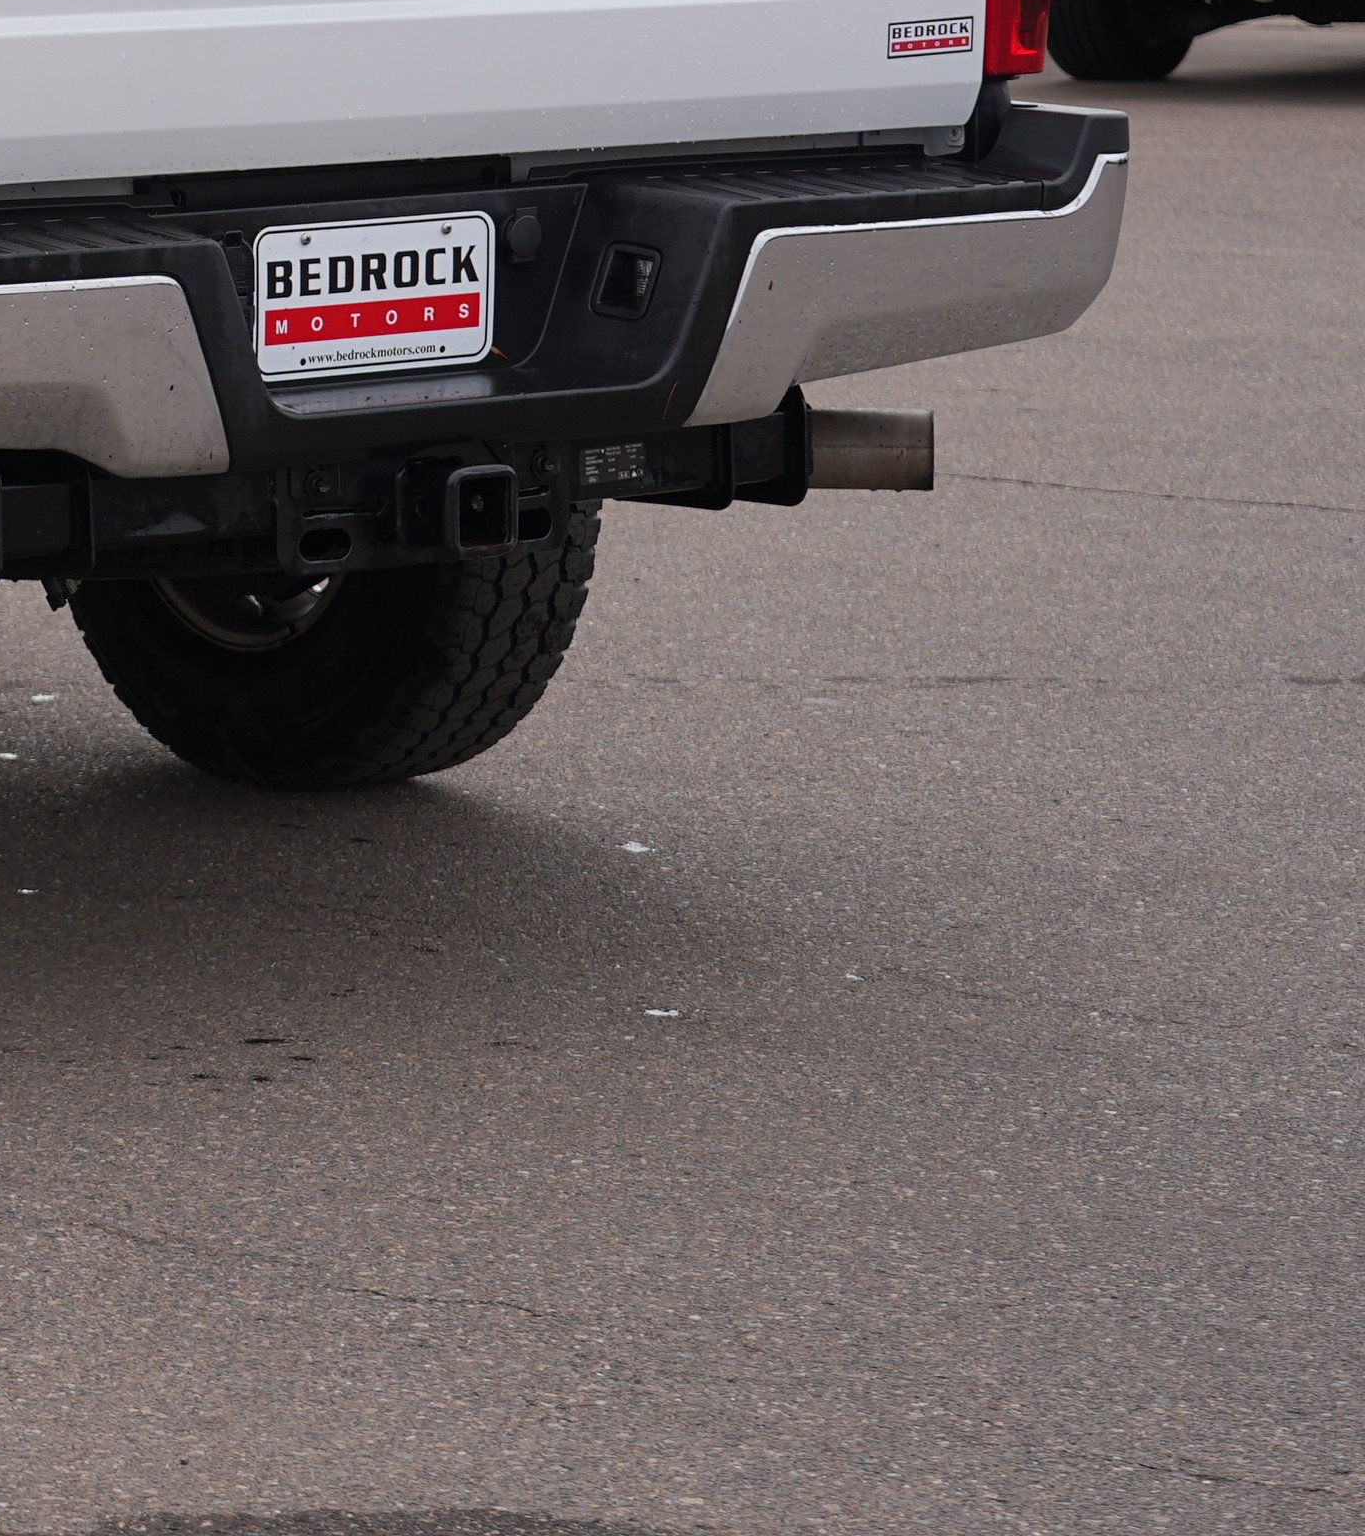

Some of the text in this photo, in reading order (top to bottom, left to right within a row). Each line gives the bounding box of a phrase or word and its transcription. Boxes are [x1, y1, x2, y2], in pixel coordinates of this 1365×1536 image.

[892, 21, 969, 39] BEDROCK
[894, 38, 967, 50] MOTORS
[266, 244, 480, 300] BEDROCK
[275, 303, 470, 335] MOTORS
[308, 344, 436, 364] www.bedrockmotors.com
